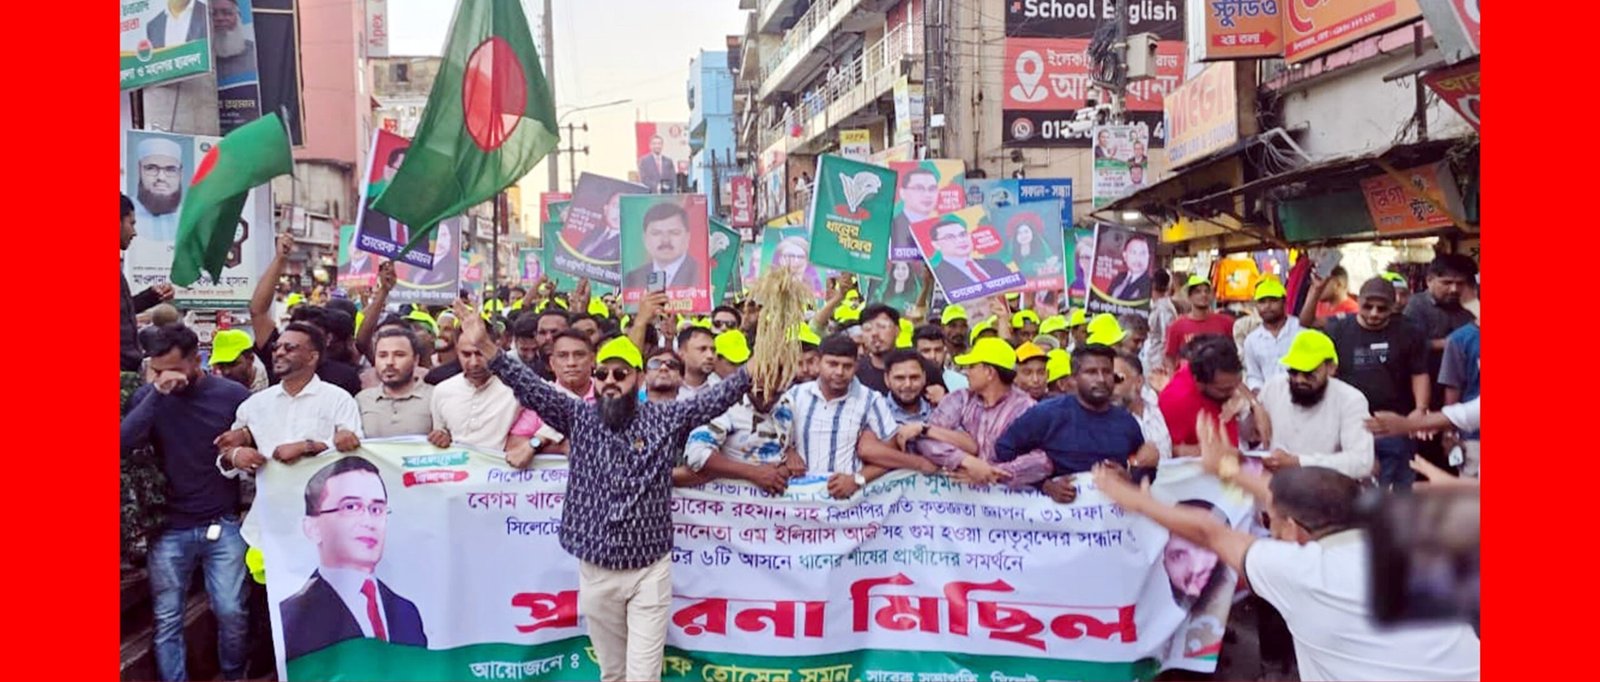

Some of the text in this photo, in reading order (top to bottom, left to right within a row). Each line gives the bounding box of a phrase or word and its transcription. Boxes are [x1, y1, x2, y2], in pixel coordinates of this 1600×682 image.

[1024, 0, 1177, 24] School Eglish
[488, 467, 534, 483] সিলেট
[466, 490, 517, 510] বেগম
[526, 490, 567, 509] খালে
[730, 502, 787, 520] রহমান
[795, 507, 821, 523] সহ
[1040, 508, 1063, 523] ৩১
[1069, 503, 1104, 520] দফা
[671, 522, 731, 542] ননেতা
[740, 527, 768, 544] এম
[774, 522, 836, 545] ইলিয়াস
[881, 524, 903, 540] সহ
[908, 525, 935, 540] গুম
[941, 526, 981, 543] হওয়া
[988, 527, 1072, 552] নেতৃবৃন্দের
[1076, 528, 1123, 548] সন্ধান
[701, 544, 733, 567] ৬টি
[738, 551, 791, 570] আসনে
[799, 551, 844, 569] ধানের
[846, 546, 889, 567] শীষের
[893, 543, 961, 567] প্রার্থীদের
[964, 548, 1025, 572] সমর্থনে
[850, 572, 1139, 652] মিছিল
[470, 654, 565, 680] আয়োজনে
